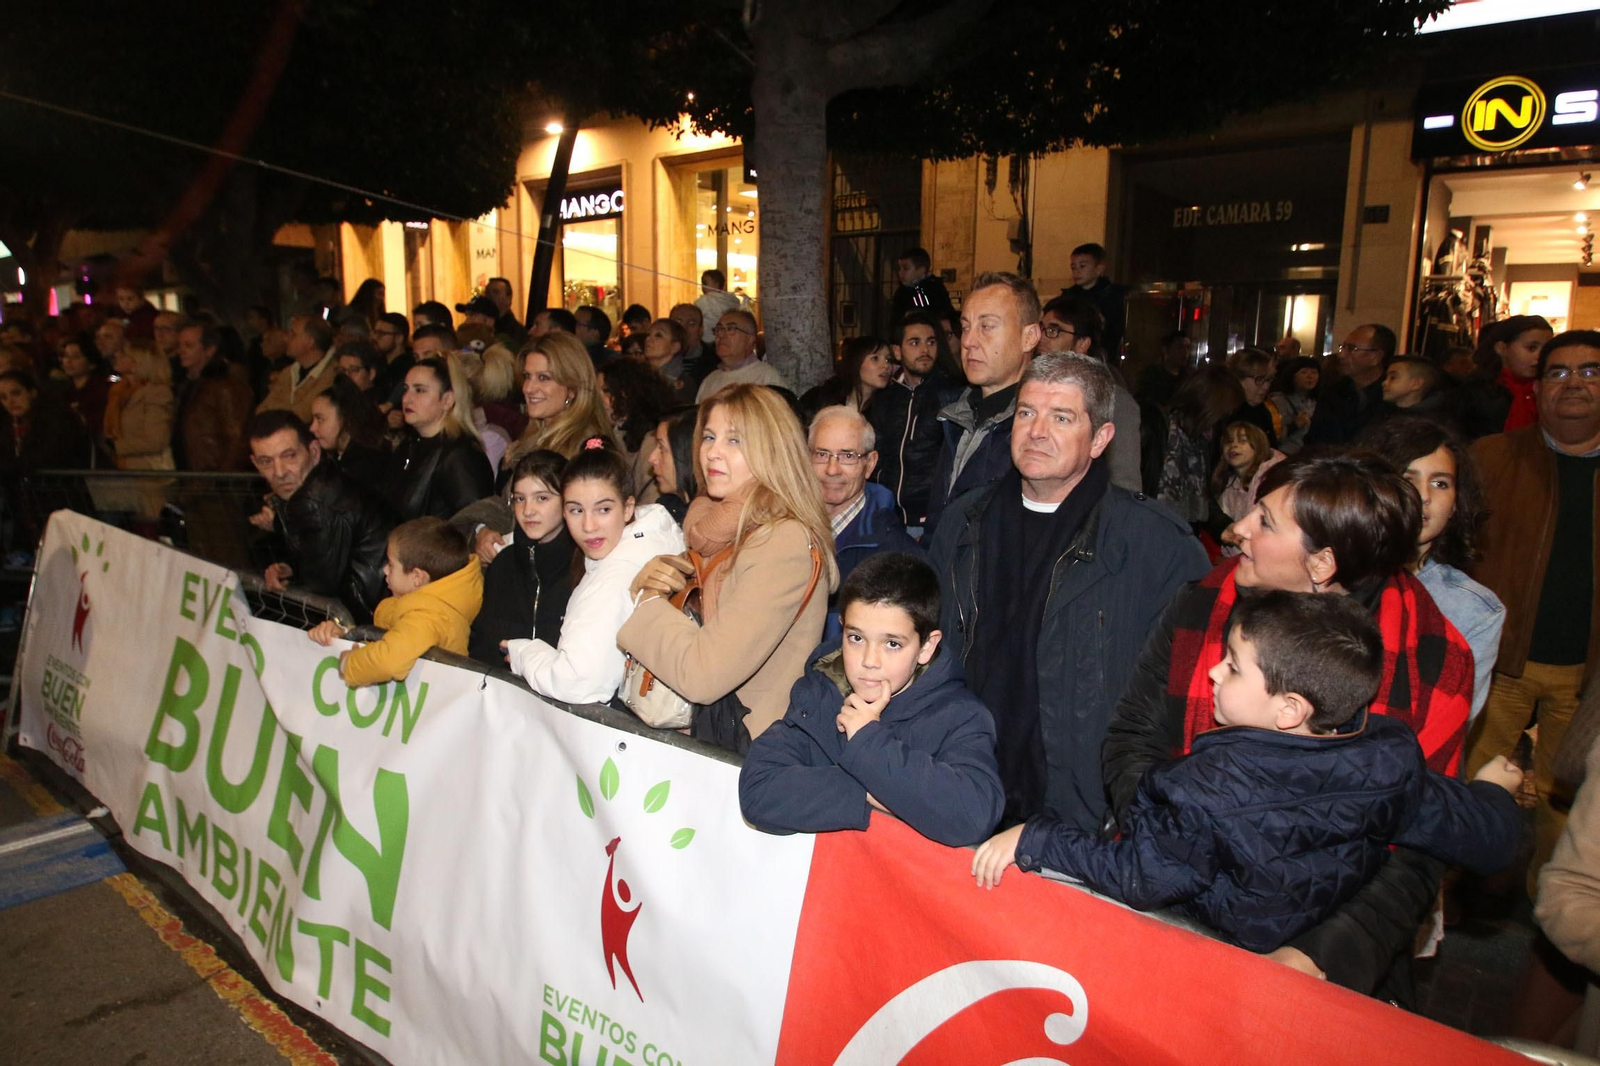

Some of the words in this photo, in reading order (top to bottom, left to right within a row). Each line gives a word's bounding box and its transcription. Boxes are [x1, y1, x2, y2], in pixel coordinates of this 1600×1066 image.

[1473, 96, 1533, 131] IN
[1552, 90, 1599, 125] S
[708, 220, 755, 237] MANG
[1206, 202, 1271, 226] CAMARA
[1275, 200, 1293, 221] 59
[41, 668, 86, 721] BUEN
[312, 656, 429, 745] CON
[145, 636, 410, 932] BUEN
[133, 782, 392, 1038] AMBIENTE
[543, 983, 637, 1054] EVENTOS
[643, 1043, 683, 1066] CO
